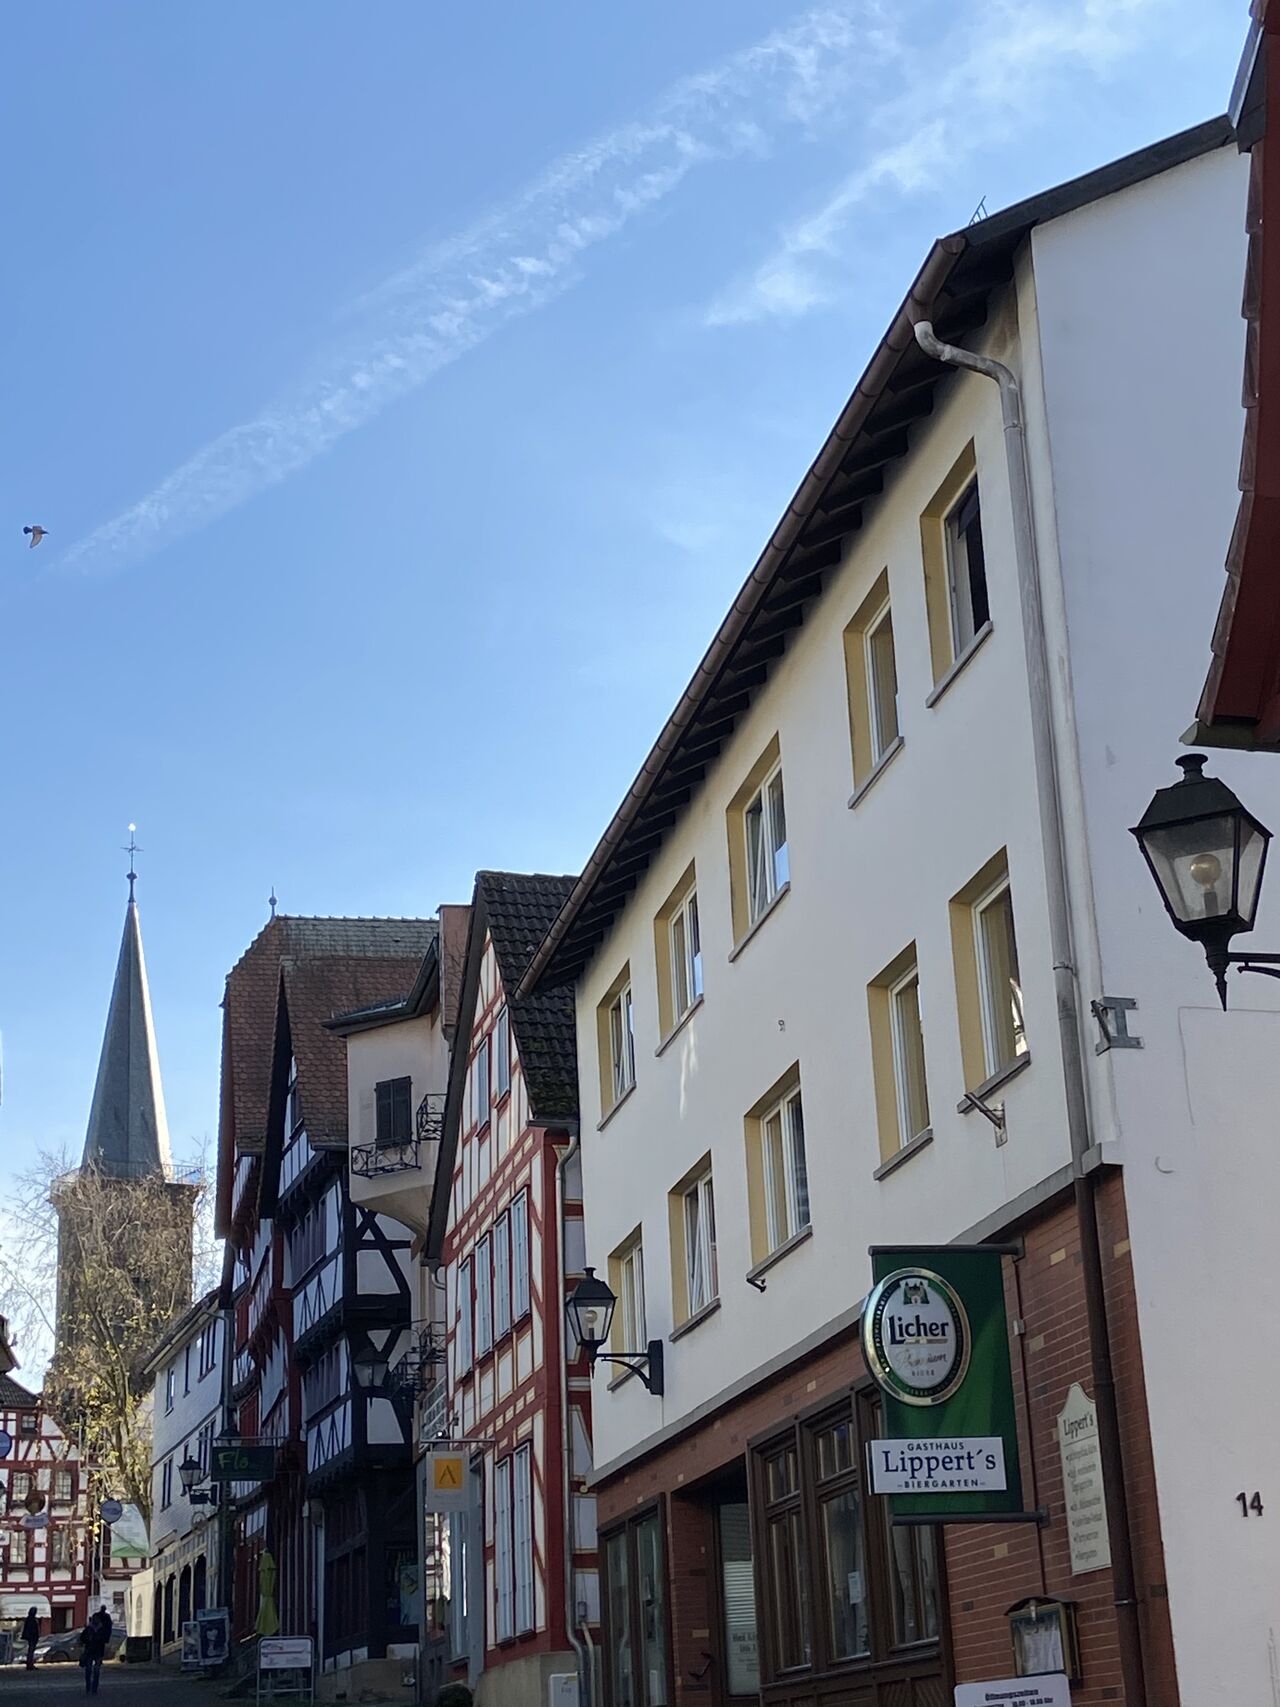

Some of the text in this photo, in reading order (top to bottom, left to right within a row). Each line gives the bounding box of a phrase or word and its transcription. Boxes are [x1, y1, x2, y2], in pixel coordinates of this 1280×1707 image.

[888, 1314, 949, 1345] Licher
[907, 1442, 964, 1452] GASTHAUS
[1235, 1491, 1264, 1518] 14
